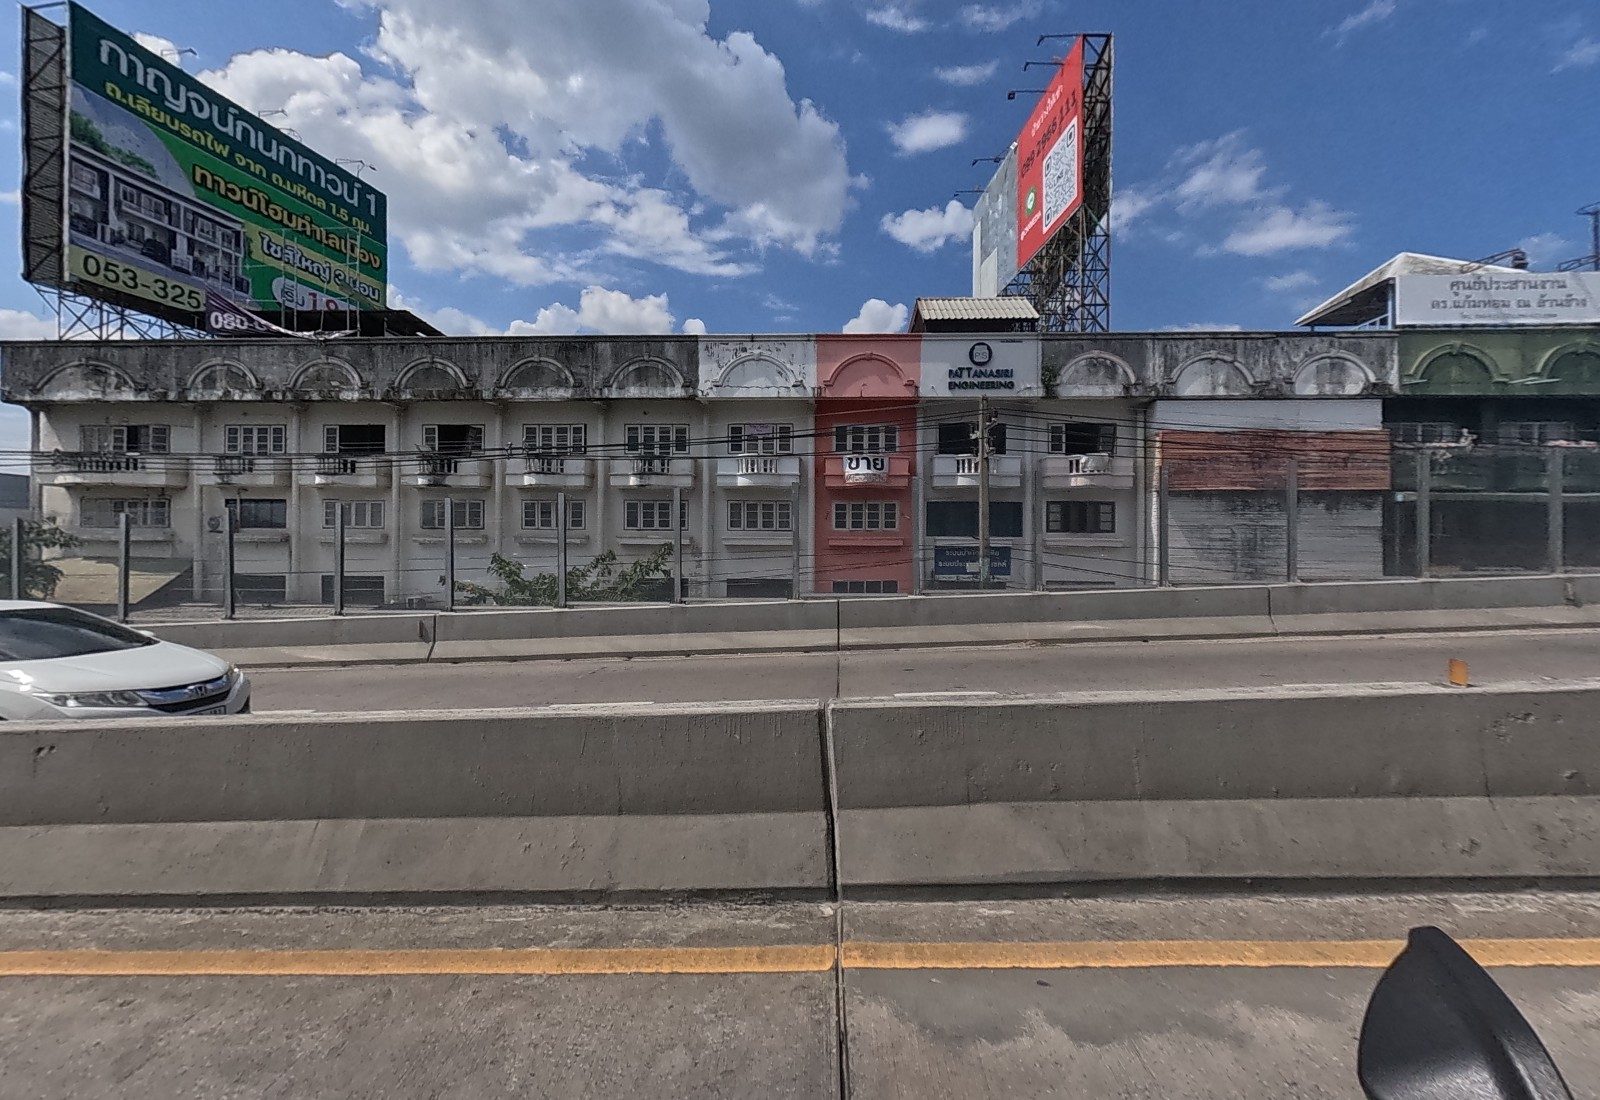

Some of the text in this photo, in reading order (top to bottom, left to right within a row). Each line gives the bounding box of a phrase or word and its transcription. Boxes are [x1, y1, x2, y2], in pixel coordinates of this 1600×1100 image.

[100, 39, 376, 217] กาญจน์กนกทาวน์ 1
[105, 81, 373, 235] ถ.เลียบรถไฟ จาก ถ.มหิดล 1.5 กม.
[948, 367, 1014, 379] PATTANASIRI
[948, 381, 1015, 390] ENGINEERING
[846, 456, 885, 471] ขาย
